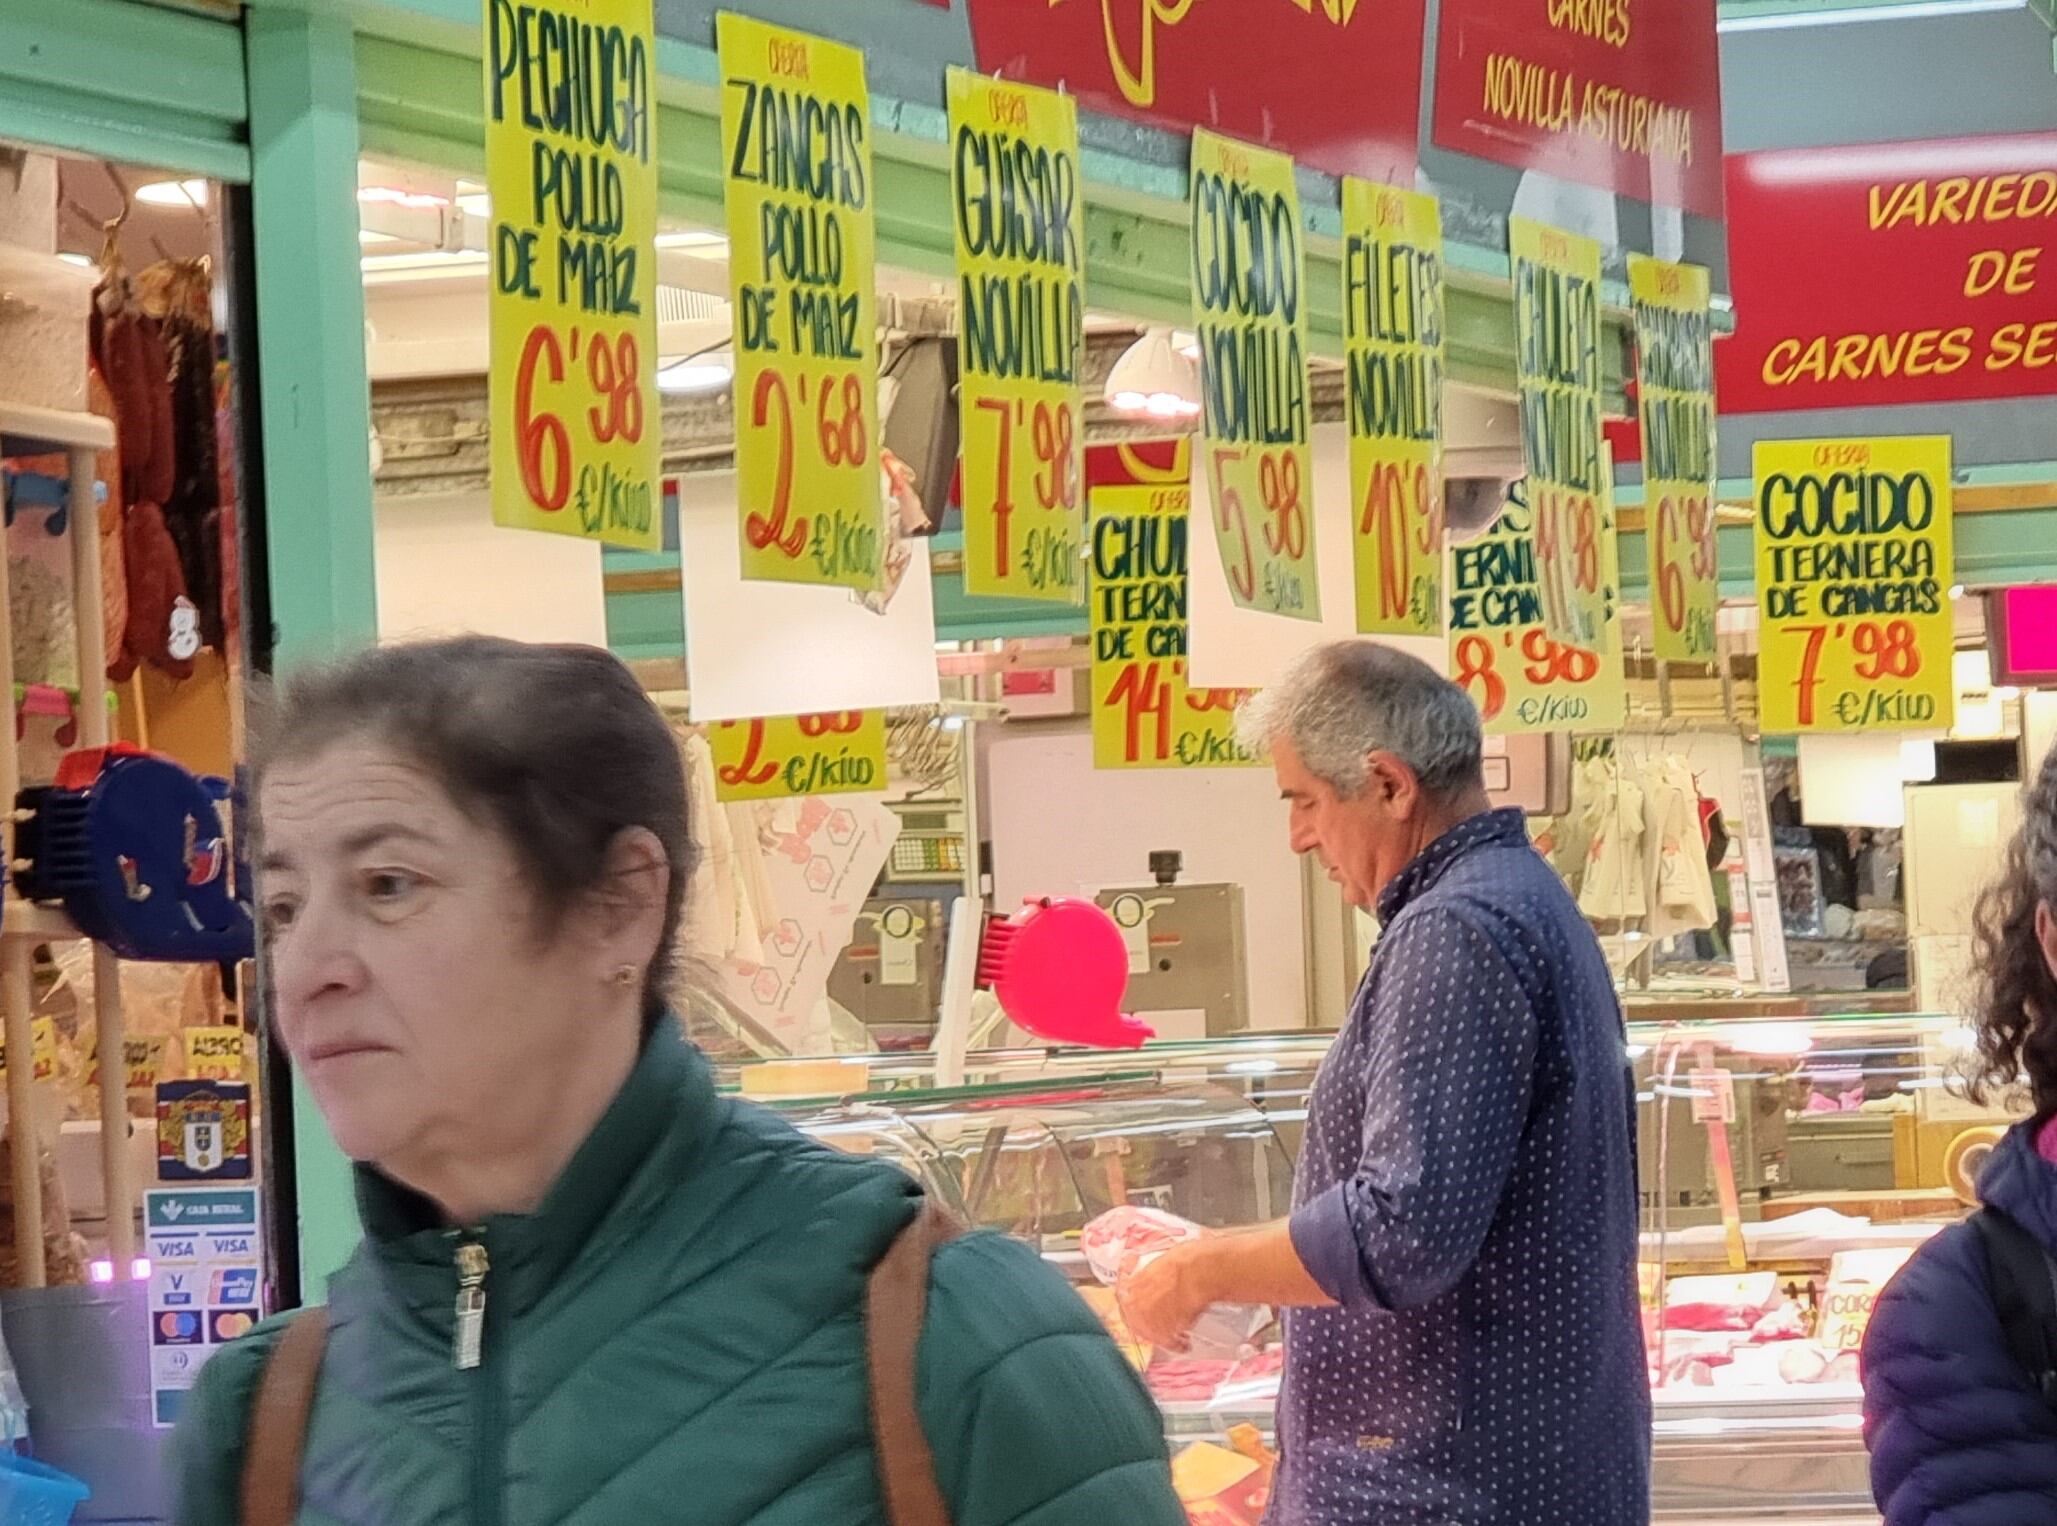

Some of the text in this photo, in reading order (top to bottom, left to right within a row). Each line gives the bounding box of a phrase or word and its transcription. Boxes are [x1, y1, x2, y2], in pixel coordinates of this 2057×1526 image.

[1547, 0, 1631, 48] CARNES
[488, 0, 649, 166] PECHUGA
[1483, 53, 1694, 168] NOVILLA ASTURIANA
[726, 79, 866, 210] ZANCAS
[533, 139, 623, 236] POLLO
[1867, 170, 2057, 231] VARIED
[496, 222, 541, 299] DE
[762, 201, 843, 288] POLLO
[1962, 247, 2043, 297] DE
[741, 285, 778, 353] DE
[1762, 327, 1974, 385] CARNES
[1984, 321, 2057, 371] SE
[515, 324, 643, 512] 6'98
[746, 367, 867, 558] 2'68
[974, 396, 1077, 578] 7'98
[1766, 538, 1934, 584] TERNERA
[1095, 580, 1188, 624] TERN
[1766, 585, 1808, 619] DE
[1096, 625, 1135, 662] DE
[1780, 620, 1922, 725] 7'98
[157, 1239, 249, 1258] VISA VISA
[1832, 1323, 1862, 1349] 15
